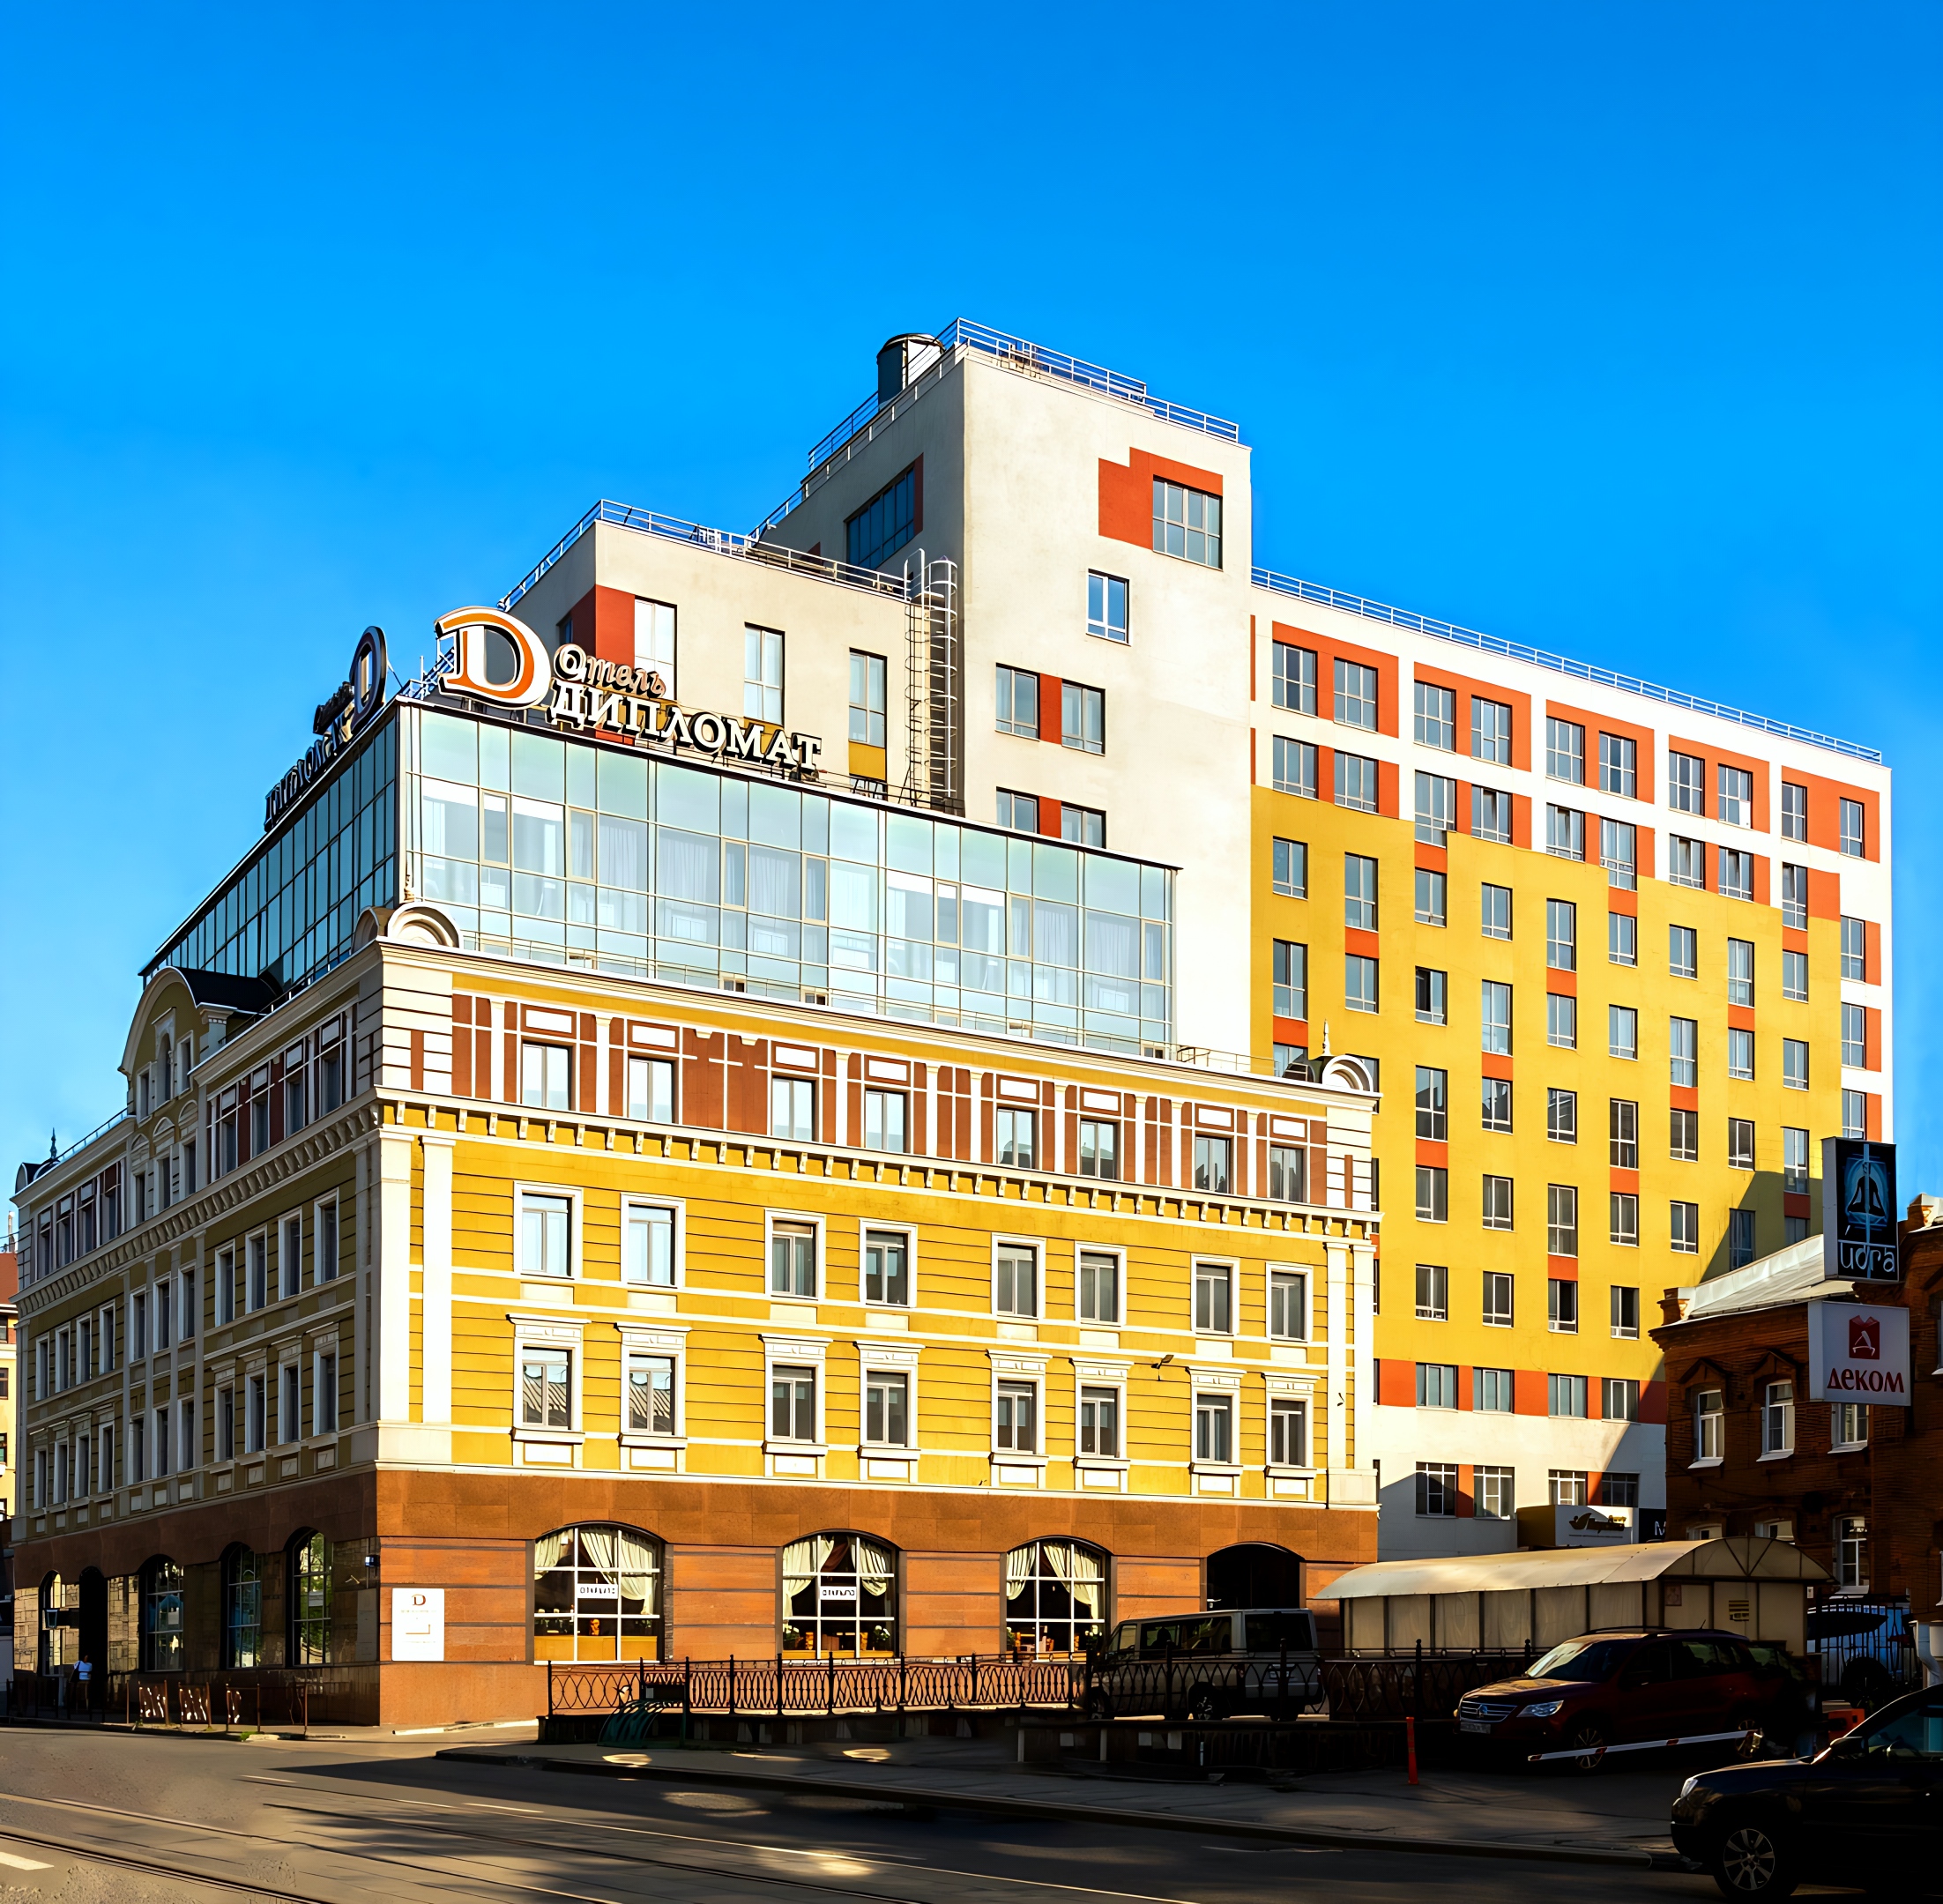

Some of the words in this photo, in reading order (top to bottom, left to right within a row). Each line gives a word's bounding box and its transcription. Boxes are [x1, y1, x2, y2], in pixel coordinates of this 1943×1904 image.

[434, 606, 552, 710] D
[554, 643, 666, 699] Отель
[545, 677, 823, 776] ДИПЛОМАТ
